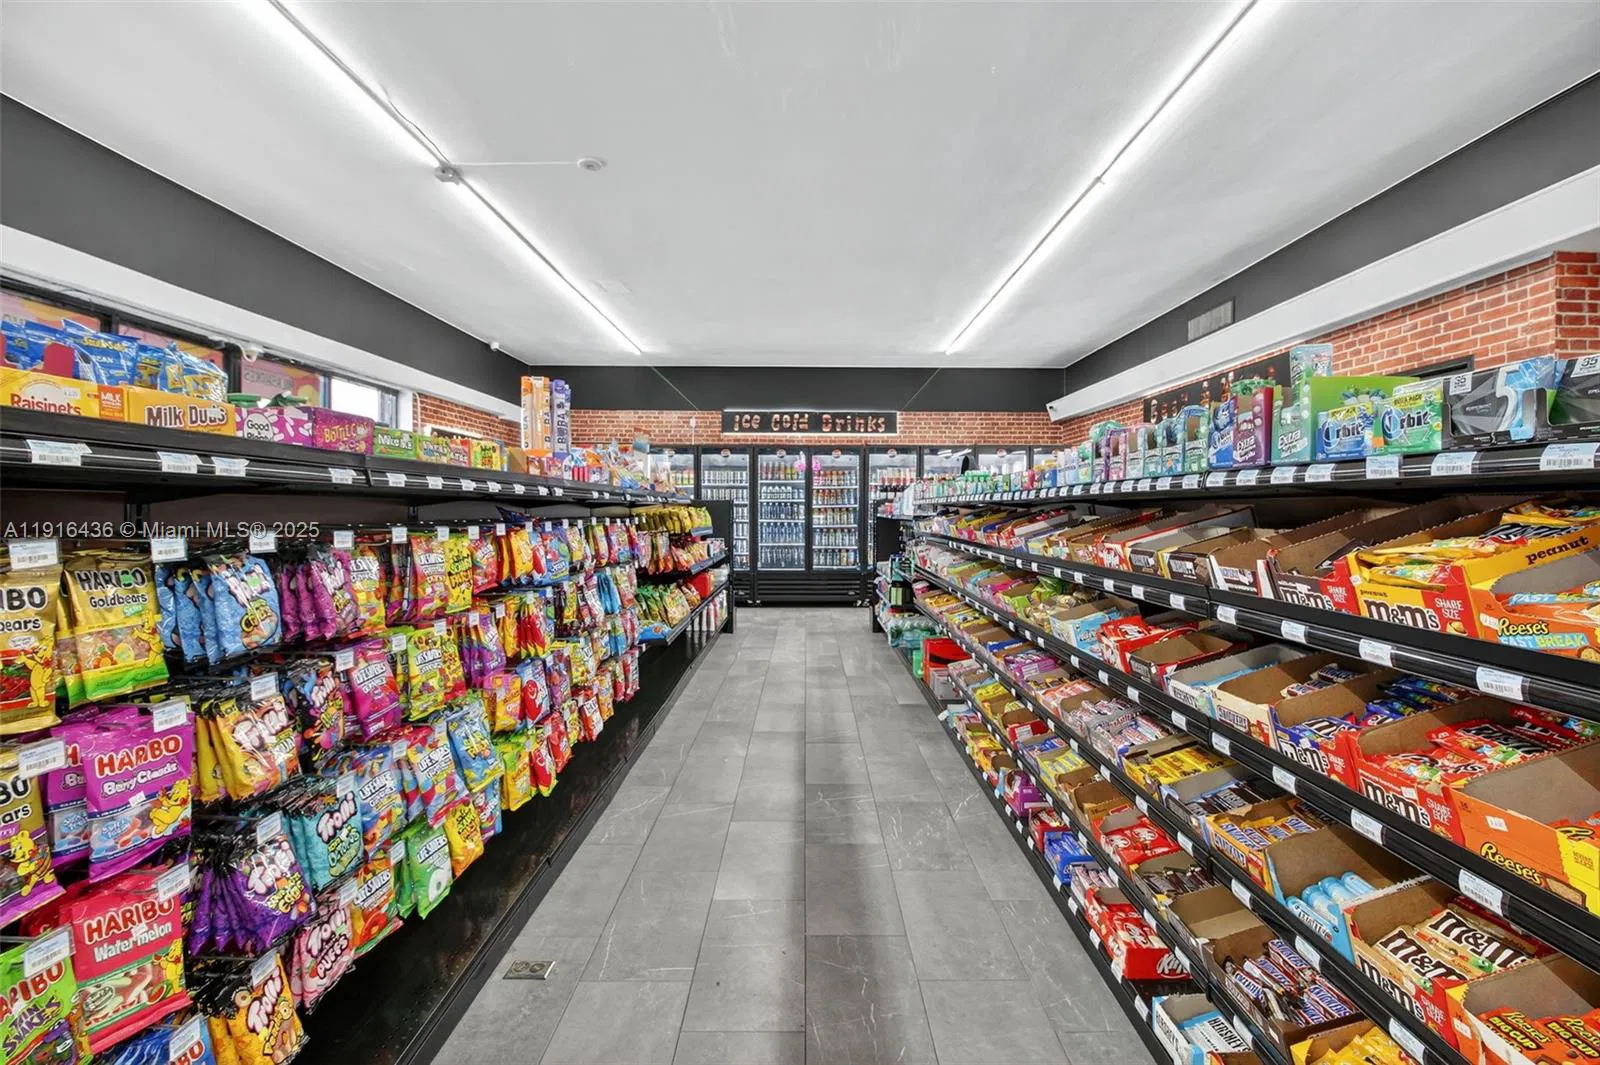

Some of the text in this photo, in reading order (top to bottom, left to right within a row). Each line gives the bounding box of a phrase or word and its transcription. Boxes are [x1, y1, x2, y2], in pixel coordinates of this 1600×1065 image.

[10, 392, 82, 416] Raisinets
[146, 406, 184, 426] Milk
[246, 420, 269, 432] Good
[771, 413, 809, 431] Cold
[822, 415, 886, 432] Drinks
[1525, 535, 1590, 565] peanut
[76, 567, 146, 591] HARIO
[90, 593, 148, 609] Goldbears
[1434, 597, 1464, 610] SHARE
[1442, 608, 1461, 620] SIZE
[1498, 617, 1550, 637] Reese's
[1536, 632, 1586, 648] BREAK
[1480, 842, 1543, 885] Reese's
[84, 899, 174, 945] HARIBO
[1489, 1016, 1513, 1033] BIG
[1509, 1031, 1538, 1049] CUP
[1547, 1021, 1600, 1058] BIG CUP
